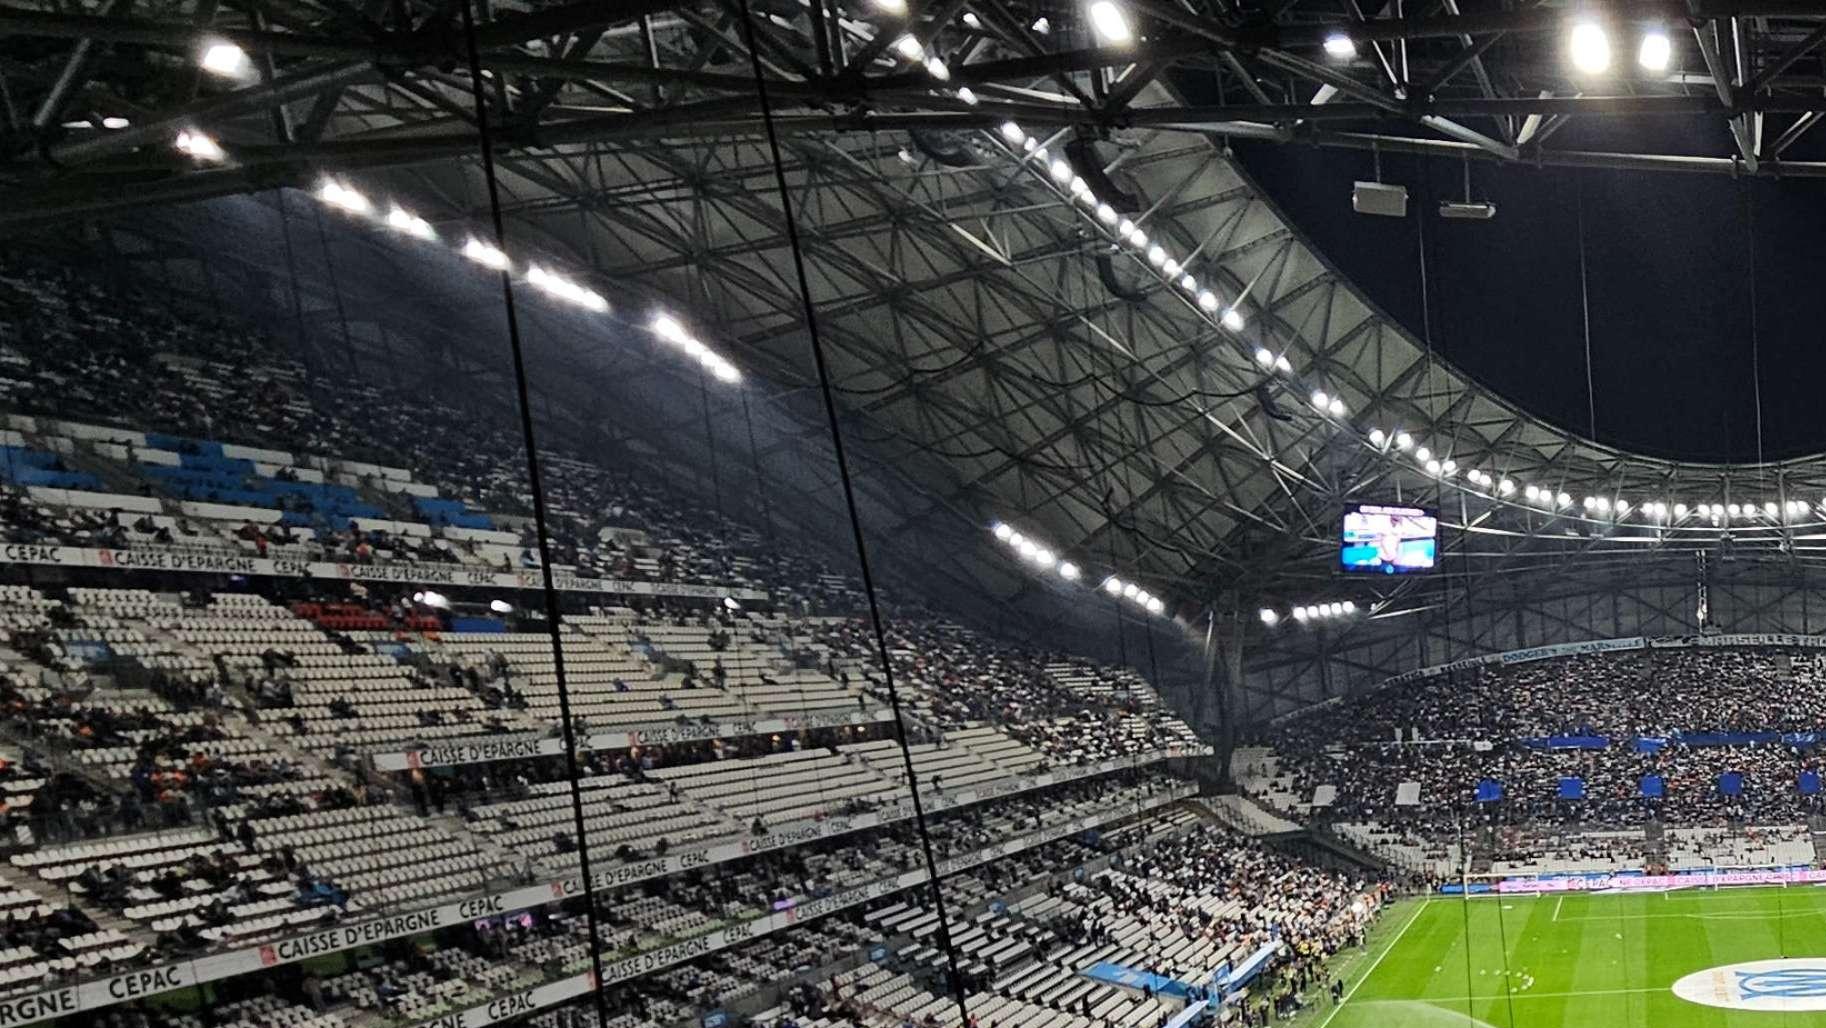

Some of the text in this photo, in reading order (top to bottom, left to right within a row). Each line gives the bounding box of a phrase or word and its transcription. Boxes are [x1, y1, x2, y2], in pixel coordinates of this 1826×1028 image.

[5, 545, 62, 562] CEPAC
[115, 552, 166, 568] CAISSE
[420, 735, 593, 766] CAISSE D'EPARGNE CPAC
[605, 859, 668, 886] D'EPARGNE
[278, 896, 504, 959] CAISSE D'EPARGNE CEPAC
[645, 936, 709, 969] D'EPARGNE
[109, 967, 181, 999] CEPAC
[487, 991, 536, 1020] CEPAC
